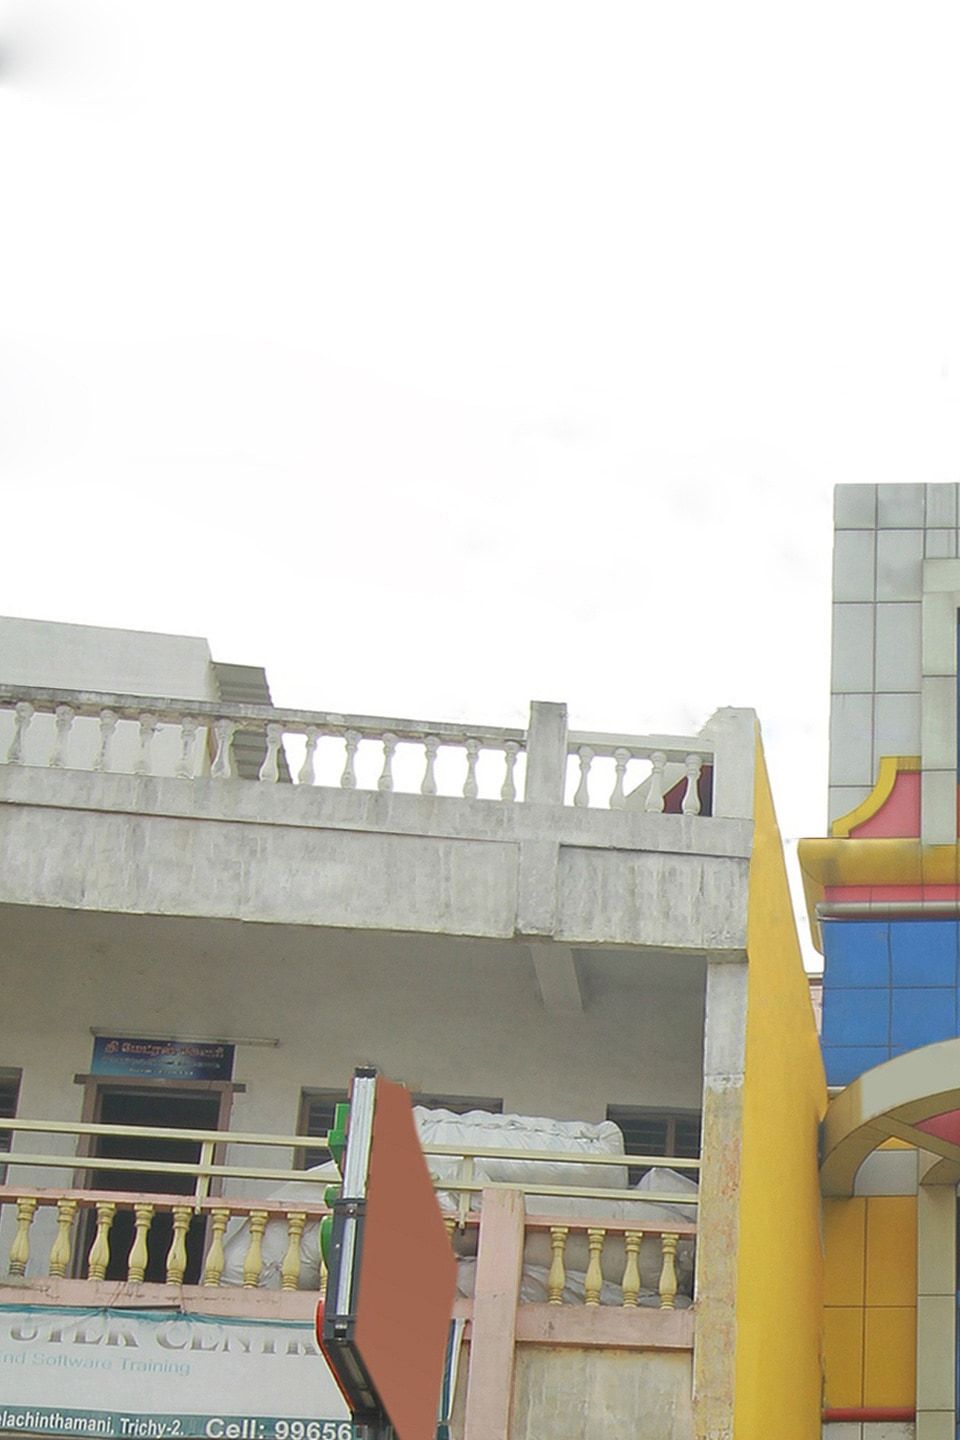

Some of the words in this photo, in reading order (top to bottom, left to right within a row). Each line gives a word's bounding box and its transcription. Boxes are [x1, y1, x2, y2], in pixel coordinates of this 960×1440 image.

[32, 1351, 112, 1370] Software
[120, 1358, 192, 1377] Training
[0, 1410, 115, 1435] lachinthamani,
[120, 1418, 184, 1438] Trichy-2.
[206, 1418, 265, 1440] Cell:
